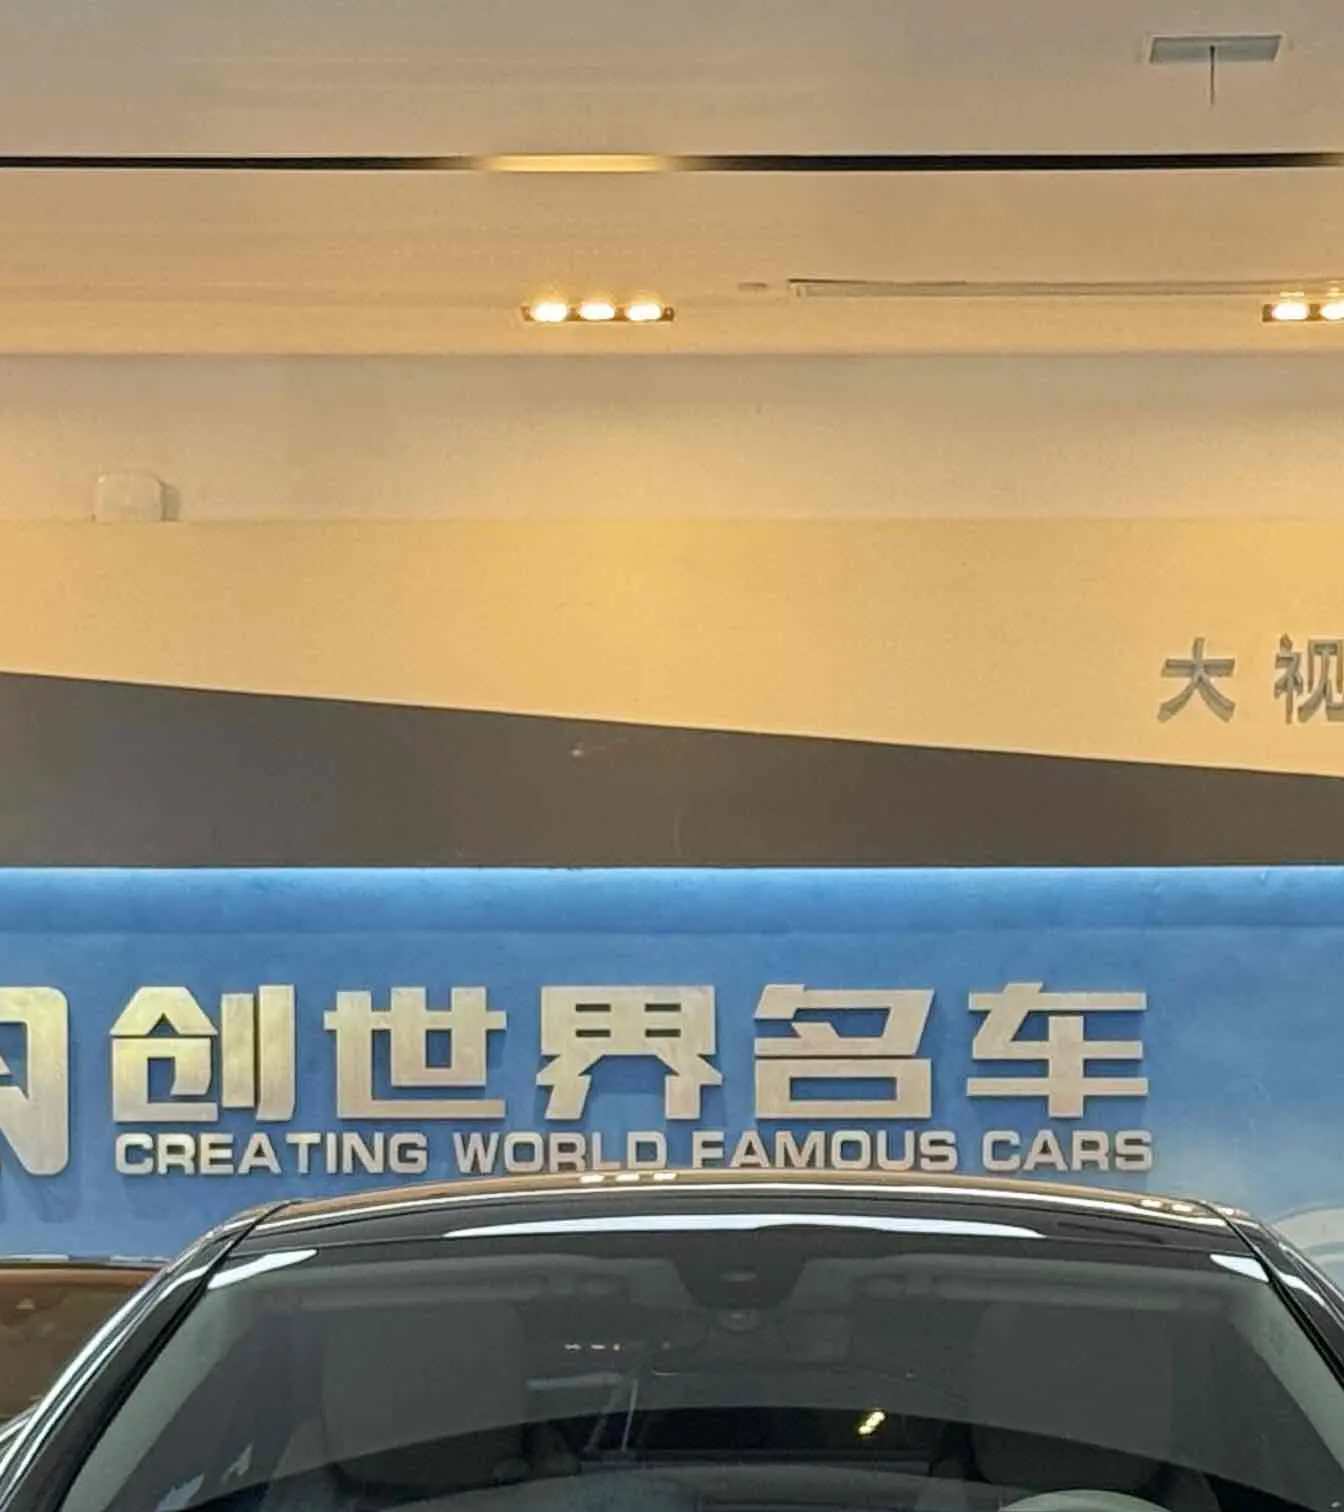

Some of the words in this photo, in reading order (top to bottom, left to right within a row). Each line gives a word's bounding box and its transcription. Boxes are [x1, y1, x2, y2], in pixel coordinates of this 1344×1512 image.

[109, 982, 1150, 1125] 创世界名车
[114, 1131, 429, 1175] CREATING
[453, 1131, 667, 1173] WORLD
[691, 1129, 957, 1171] FAMOUS
[981, 1129, 1153, 1172] CARS
